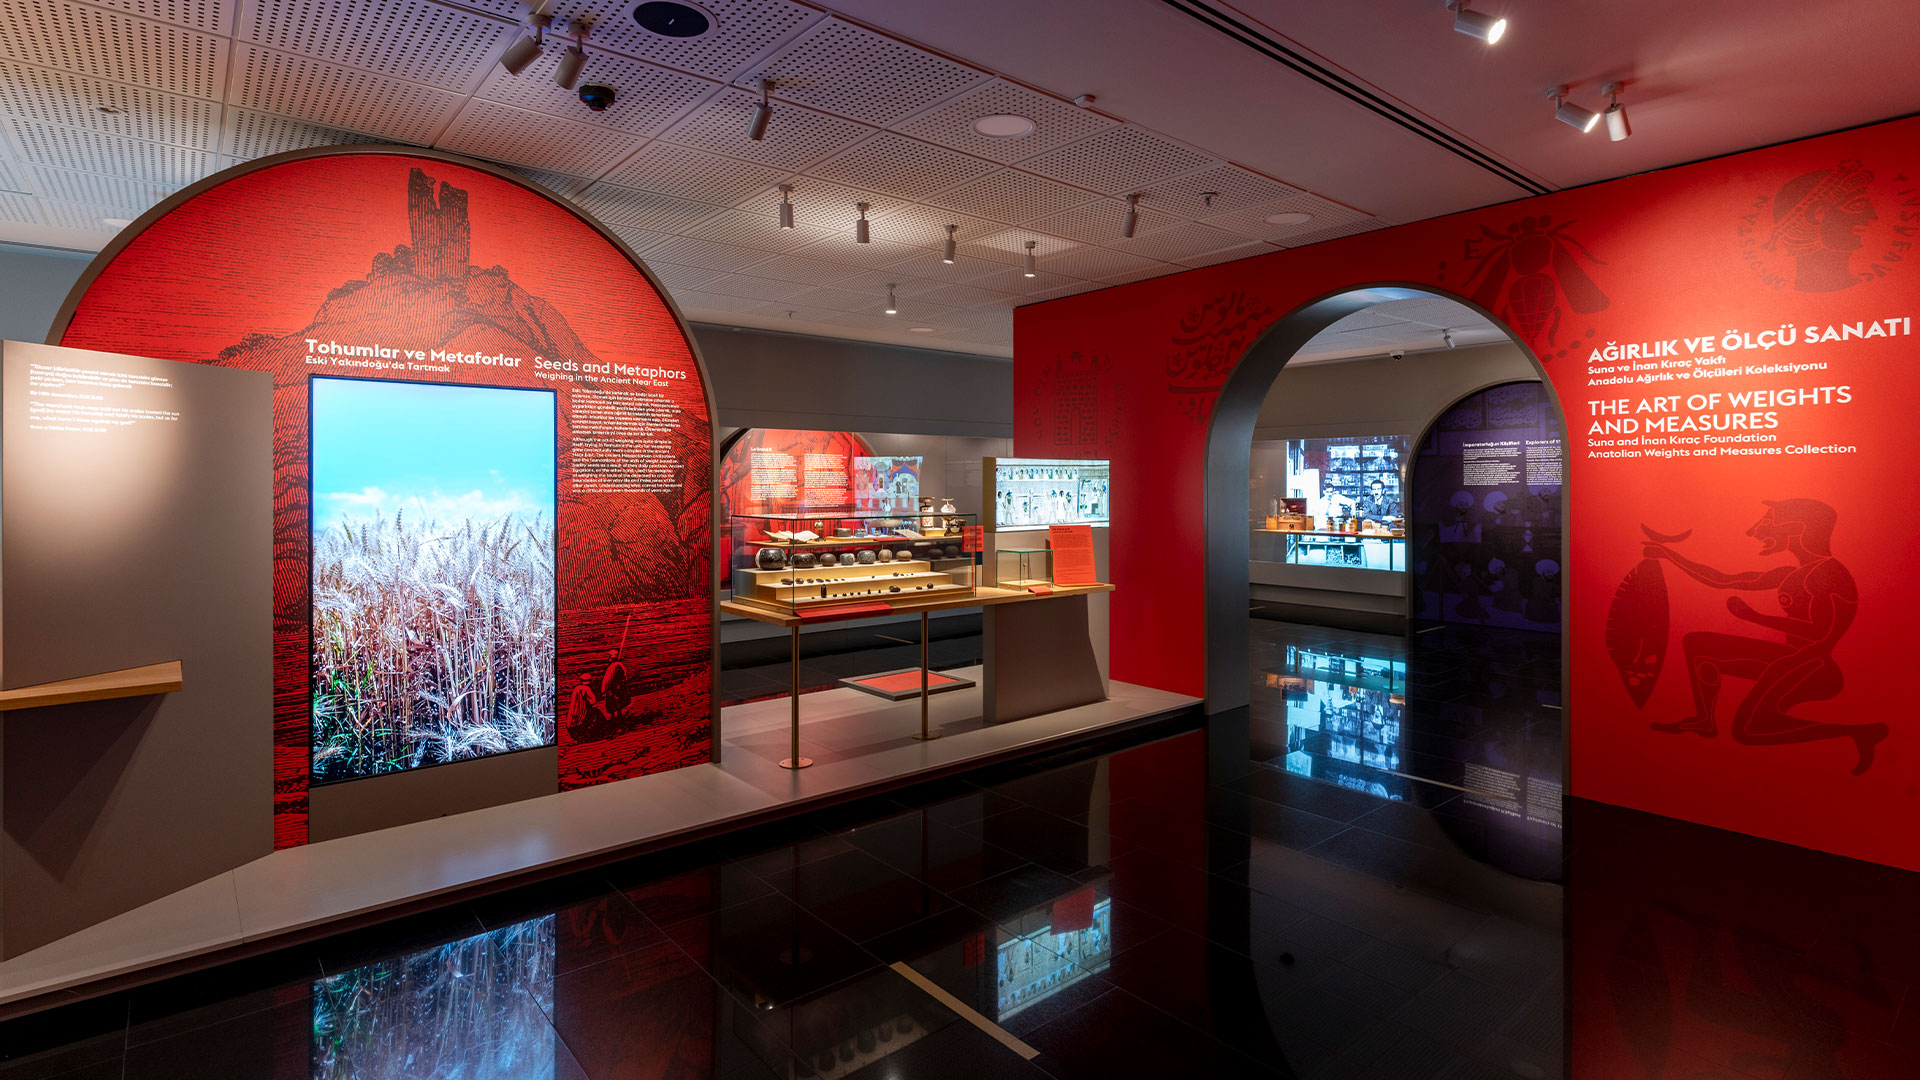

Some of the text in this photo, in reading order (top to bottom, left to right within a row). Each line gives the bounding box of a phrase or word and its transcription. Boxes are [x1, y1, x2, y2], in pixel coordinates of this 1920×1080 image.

[1587, 316, 1910, 363] AĞIRLIK VE ÖLÇÜ SANATI
[305, 338, 521, 367] Tohumlar ve Metaforlar
[305, 355, 450, 372] Eski Yakındoğu'da Tartmak
[1587, 366, 1615, 374] Suna
[1632, 361, 1658, 371] İnan
[1660, 359, 1692, 368] Kıraç
[1694, 354, 1726, 365] Vakfı
[533, 370, 668, 386] Weighing in the Ancient Near East
[534, 356, 686, 379] Seeds and Metaphors
[1587, 375, 1633, 386] Anadolu
[1635, 371, 1674, 384] Ağırlık
[1692, 366, 1742, 379] Ölçüleri
[1745, 362, 1827, 375] Koleksiyonu
[1587, 385, 1852, 416] THE ART OF WEIGHTS
[1587, 411, 1778, 435] AND MEASURES
[1587, 432, 1776, 446] Suna and İnan Kıraç Foundation
[1587, 443, 1856, 458] Anatolian Weights and Measures Collection
